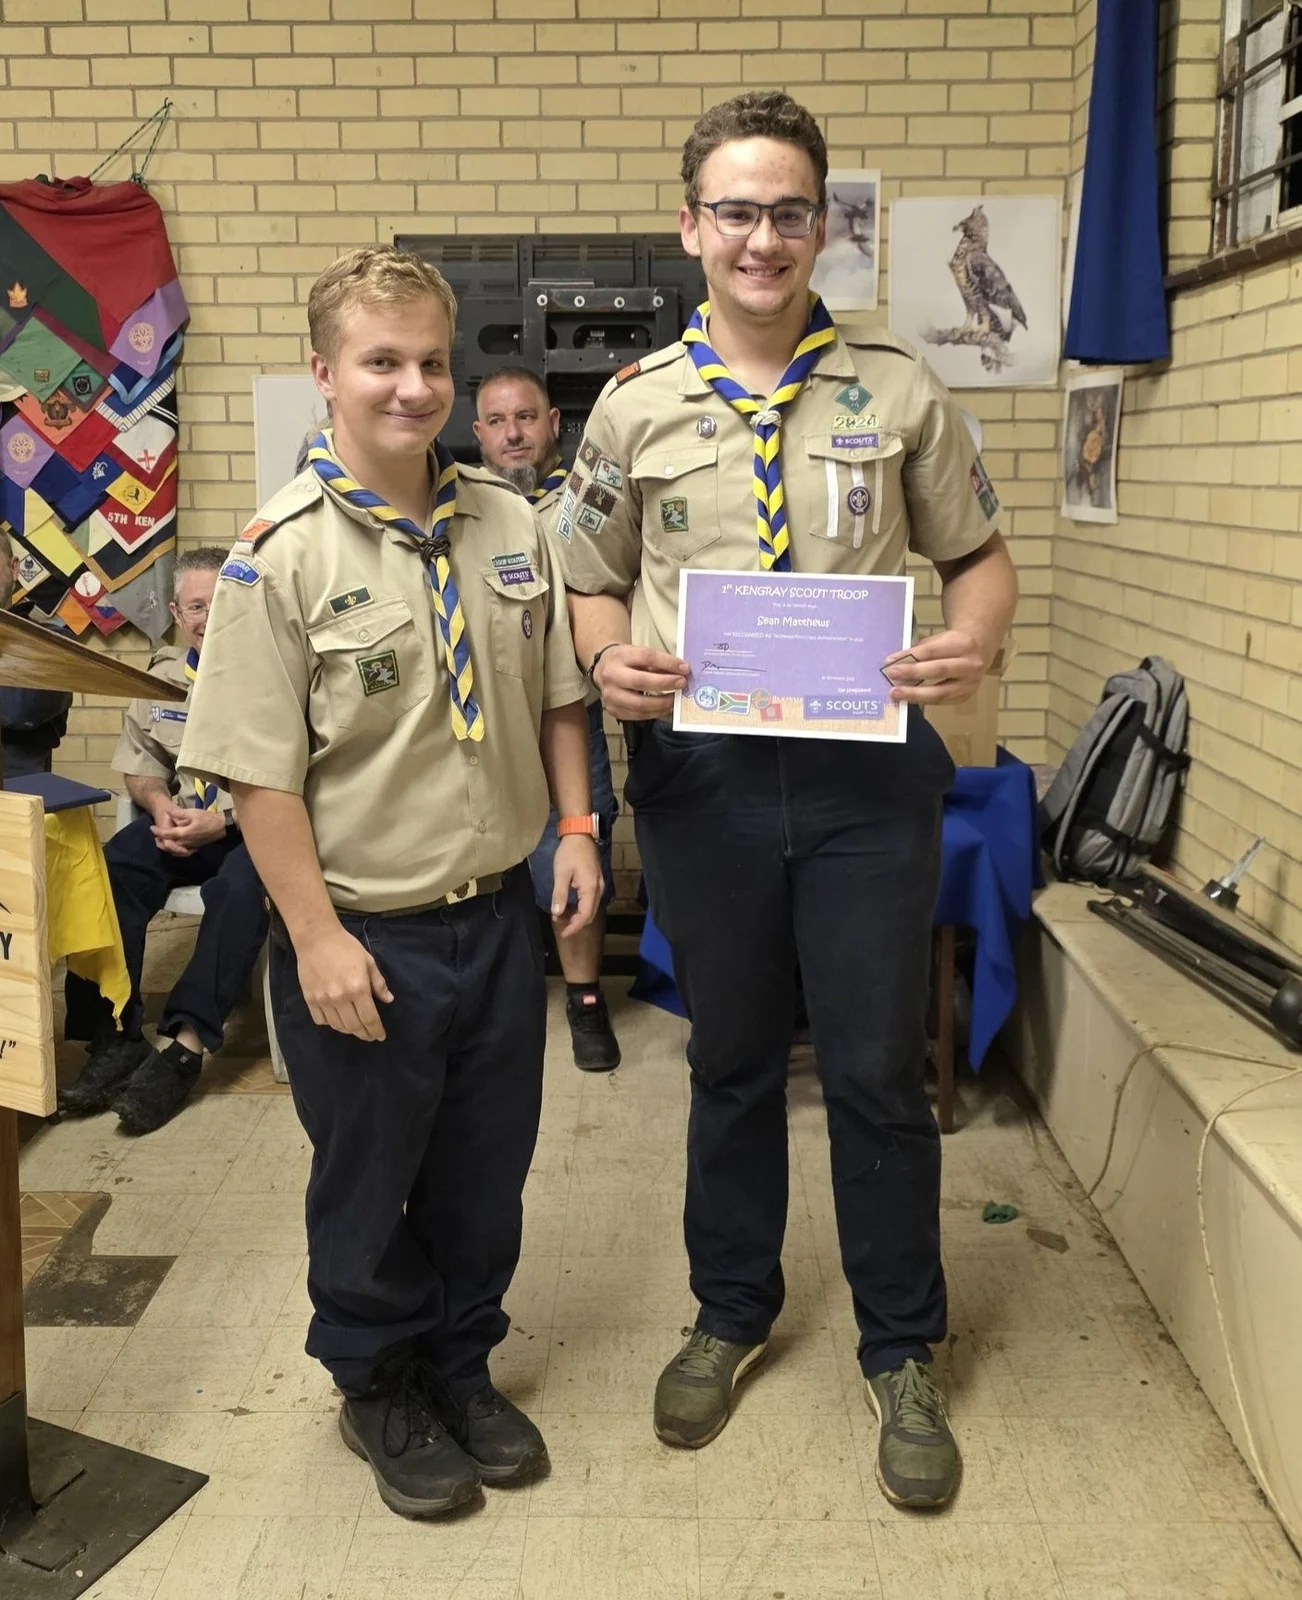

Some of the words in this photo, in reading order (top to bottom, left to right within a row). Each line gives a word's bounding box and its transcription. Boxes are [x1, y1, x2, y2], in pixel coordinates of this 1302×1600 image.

[845, 437, 875, 445] SCOUTS
[107, 512, 128, 525] 5TH
[134, 515, 155, 527] KEN
[734, 585, 788, 597] KENGRAY
[789, 587, 828, 599] SCOUT
[829, 589, 869, 600] TROOP
[757, 615, 780, 627] Sean
[782, 616, 830, 628] Matthews
[826, 700, 878, 711] SCOUTS
